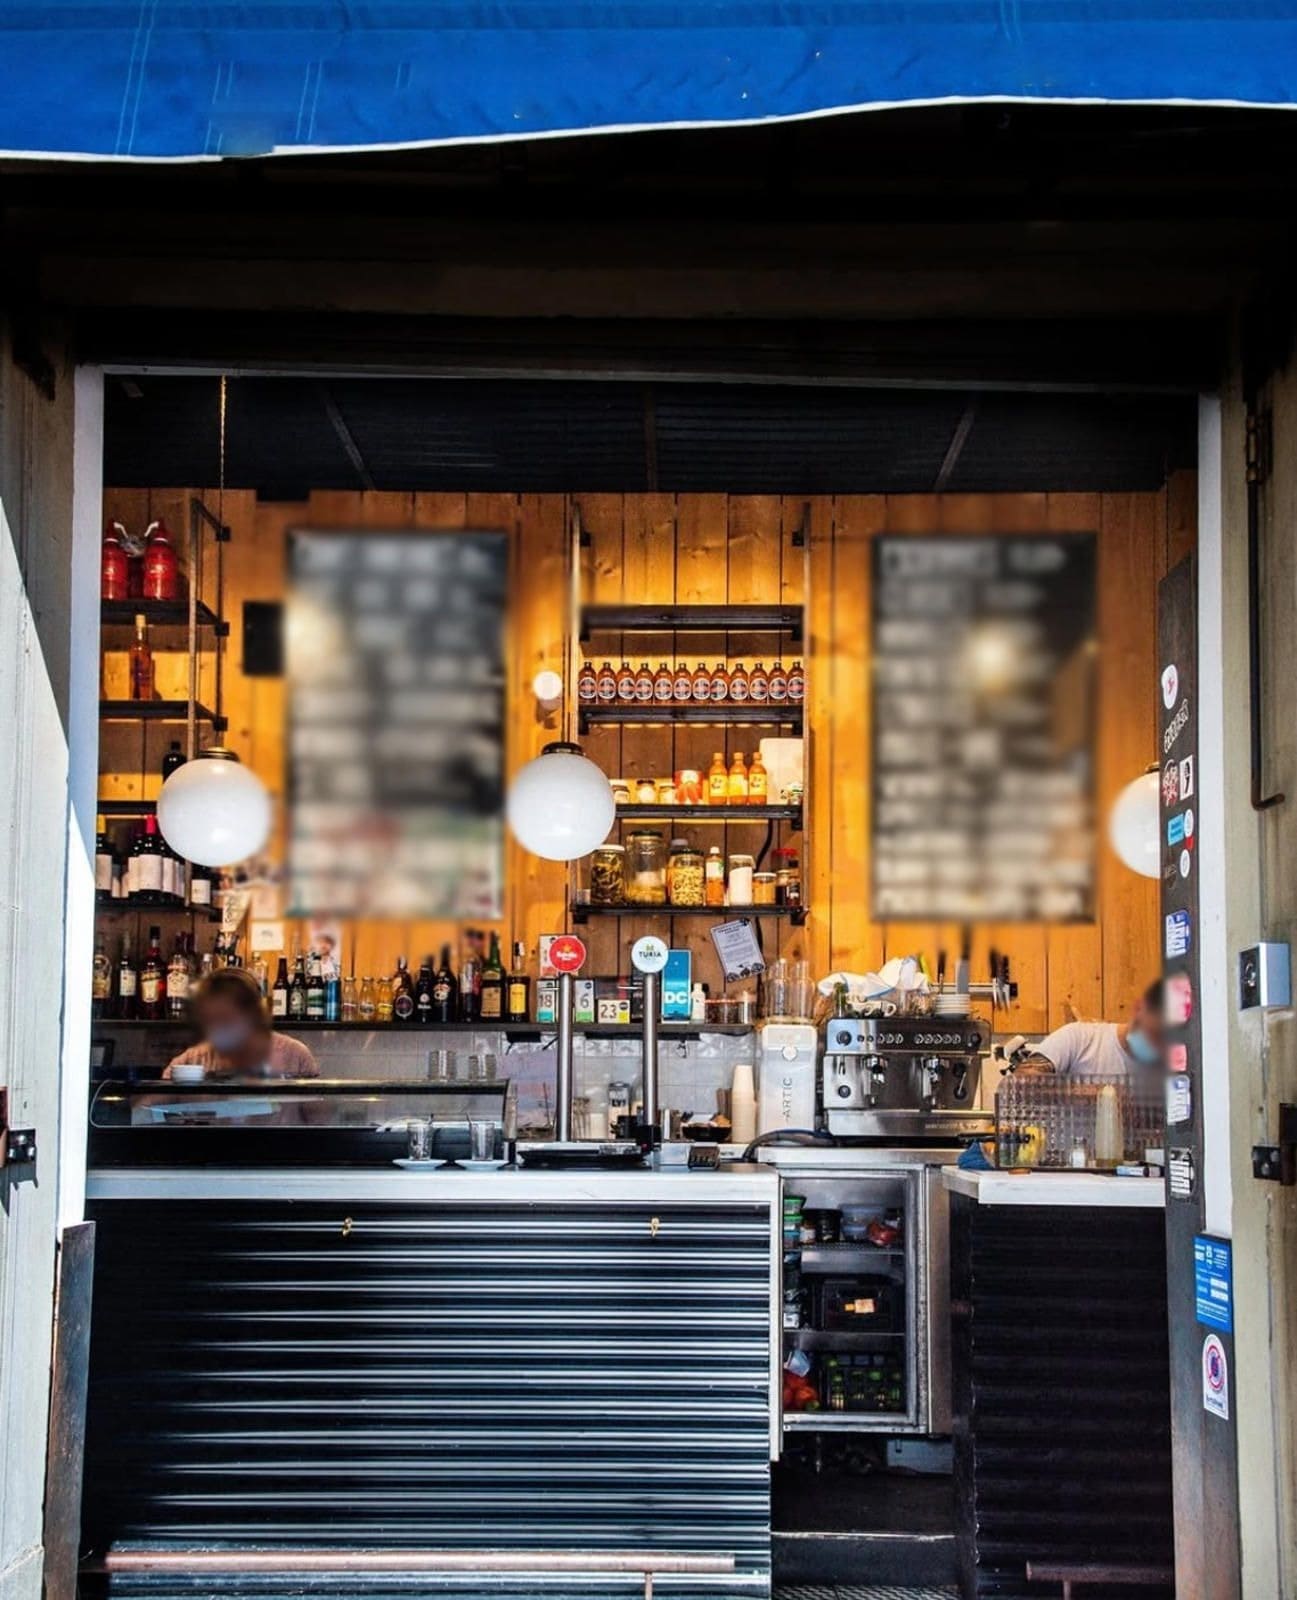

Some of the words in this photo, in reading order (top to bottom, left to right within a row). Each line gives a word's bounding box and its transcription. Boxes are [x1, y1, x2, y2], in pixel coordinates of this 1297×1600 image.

[538, 994, 552, 1007] 18
[580, 993, 590, 1008] 6
[664, 991, 688, 1004] DC
[600, 1004, 617, 1019] 23
[782, 1077, 793, 1118] ARTIC
